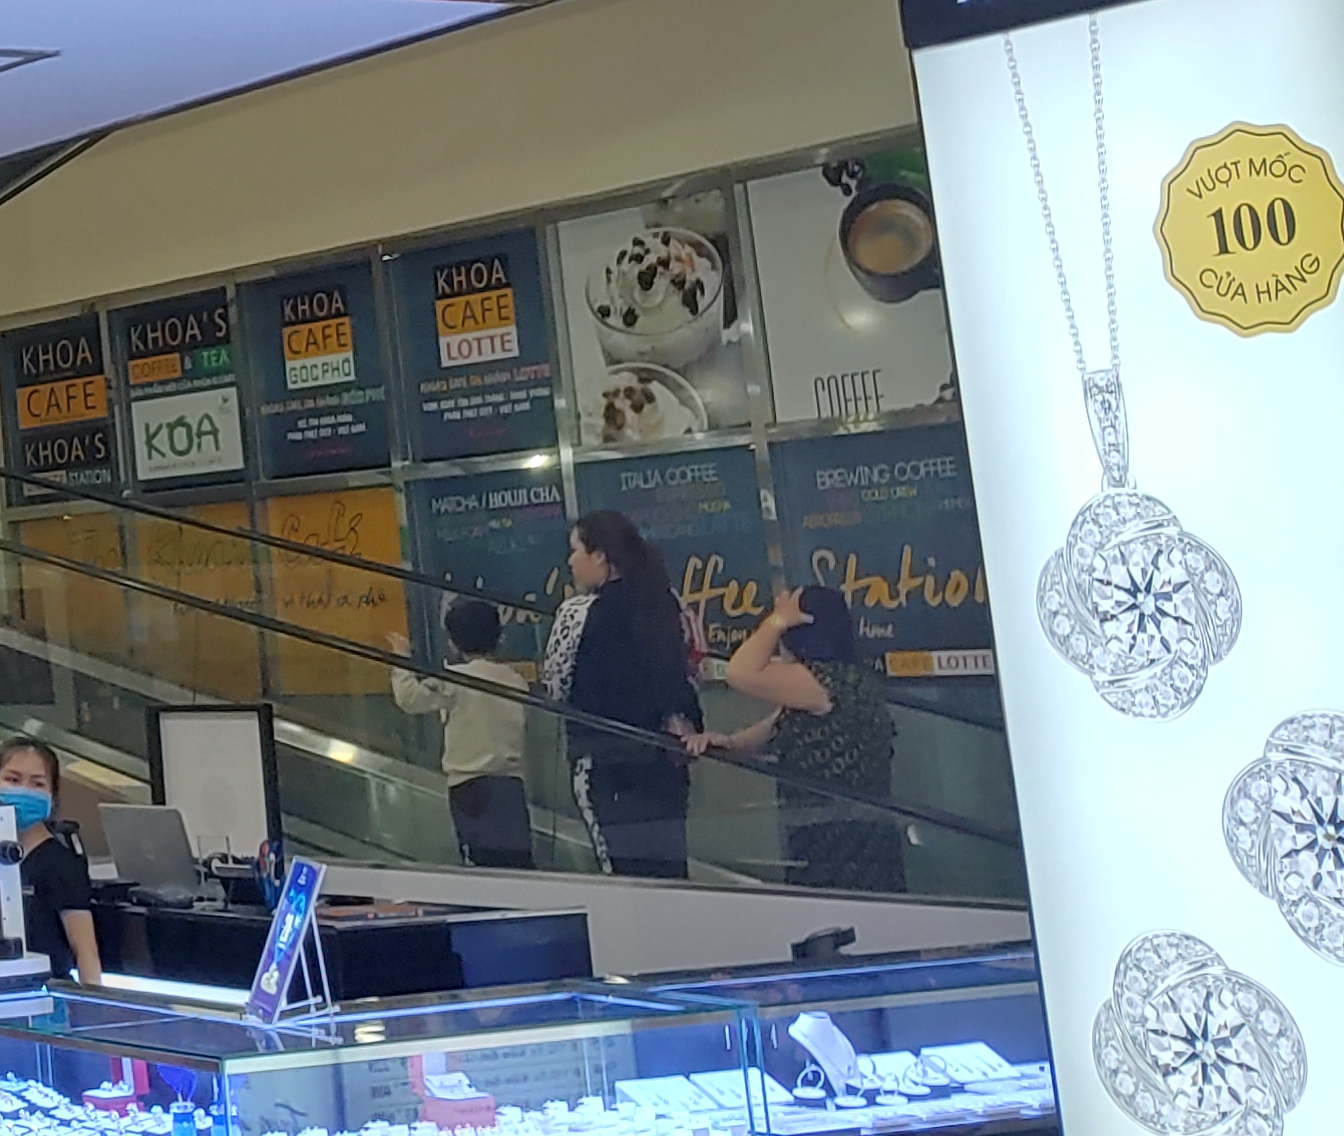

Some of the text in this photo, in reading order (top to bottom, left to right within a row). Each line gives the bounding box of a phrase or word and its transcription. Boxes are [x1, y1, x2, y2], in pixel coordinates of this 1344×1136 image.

[1186, 151, 1307, 202] VƯỢT MỐC
[1206, 196, 1297, 257] 100
[436, 258, 508, 295] KHOA
[1198, 250, 1321, 304] CỬA HÀNG
[283, 289, 345, 322] KHOA
[441, 294, 511, 330] CAFE
[130, 307, 228, 352] KHOA'S
[287, 322, 348, 356] CAFE
[446, 332, 514, 361] LOTTE
[22, 335, 93, 375] KHOA
[201, 350, 232, 368] TEA
[26, 380, 98, 418] CAFE
[25, 432, 106, 467] KHOA'S
[664, 462, 719, 486] COFFEE
[816, 456, 958, 491] BREWING COFFEE
[530, 484, 562, 503] CHA
